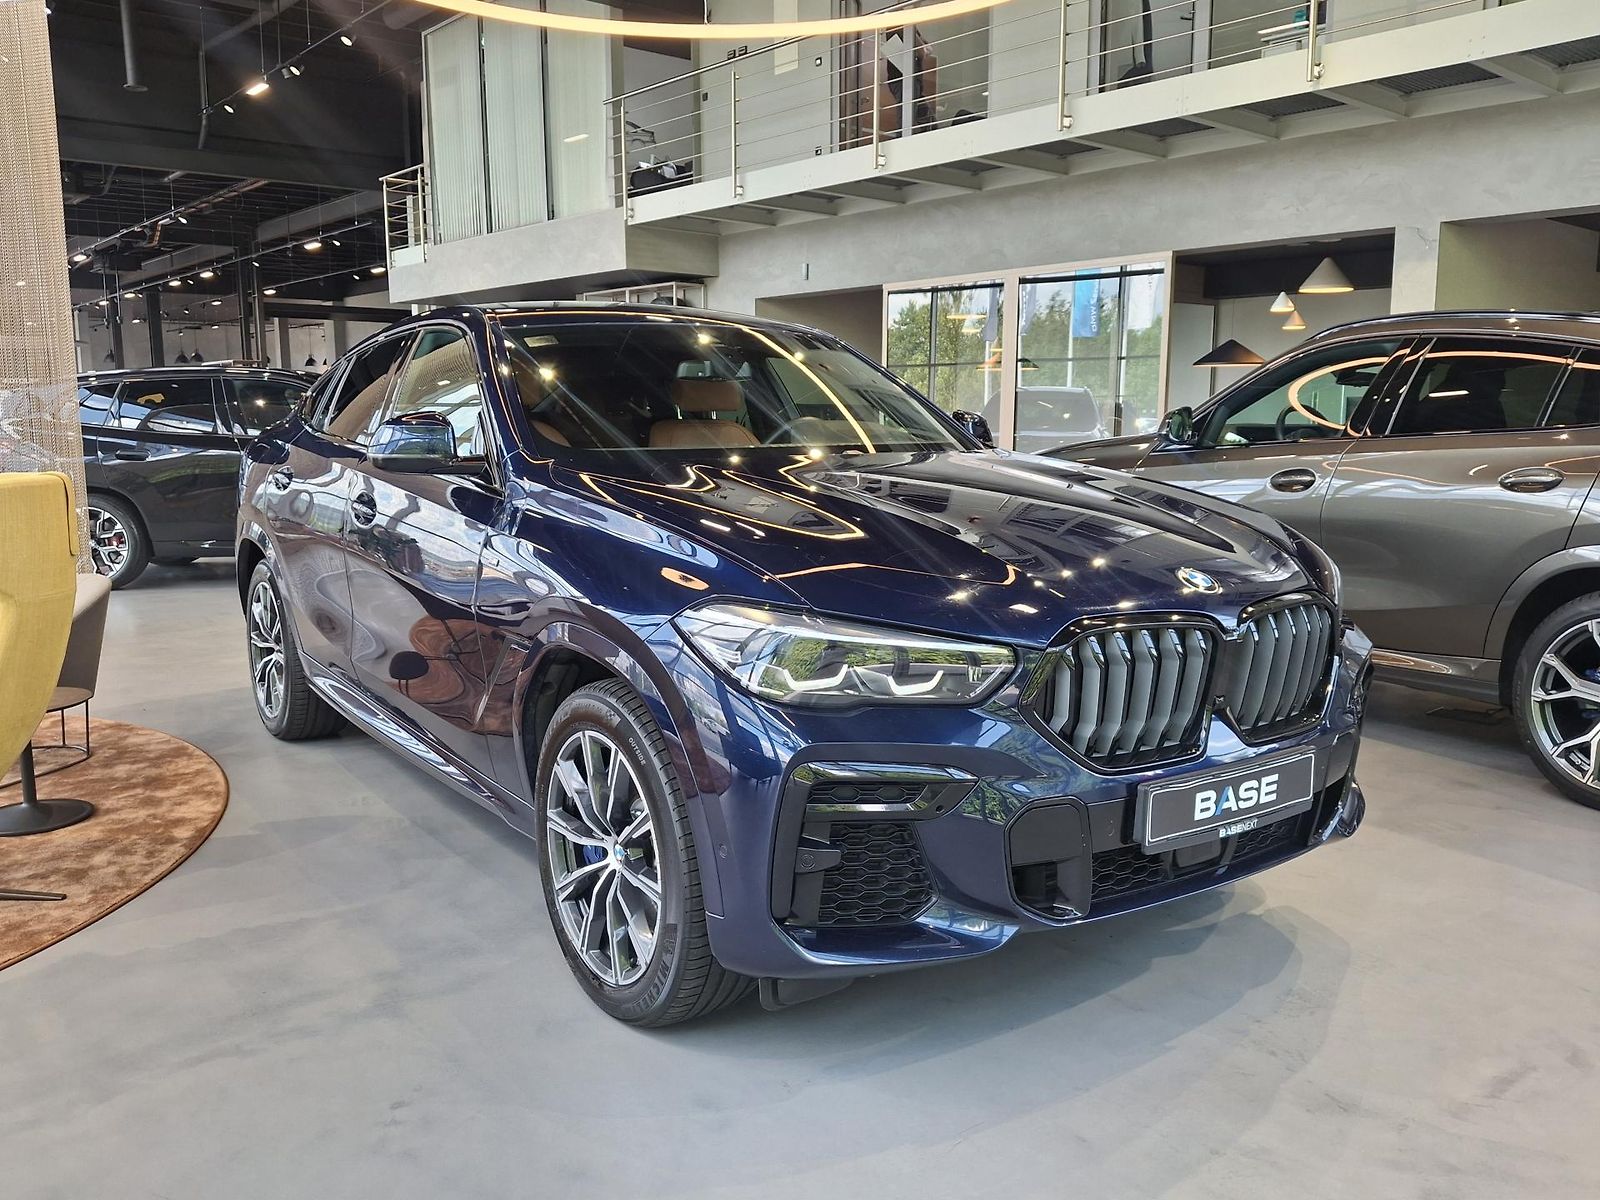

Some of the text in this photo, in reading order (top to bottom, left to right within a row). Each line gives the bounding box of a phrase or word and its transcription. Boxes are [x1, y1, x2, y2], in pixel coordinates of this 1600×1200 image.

[628, 737, 646, 766] OUTSIDE
[1194, 774, 1278, 820] BASE
[1219, 819, 1258, 838] BASENEXT
[620, 958, 671, 1014] MICHEL
